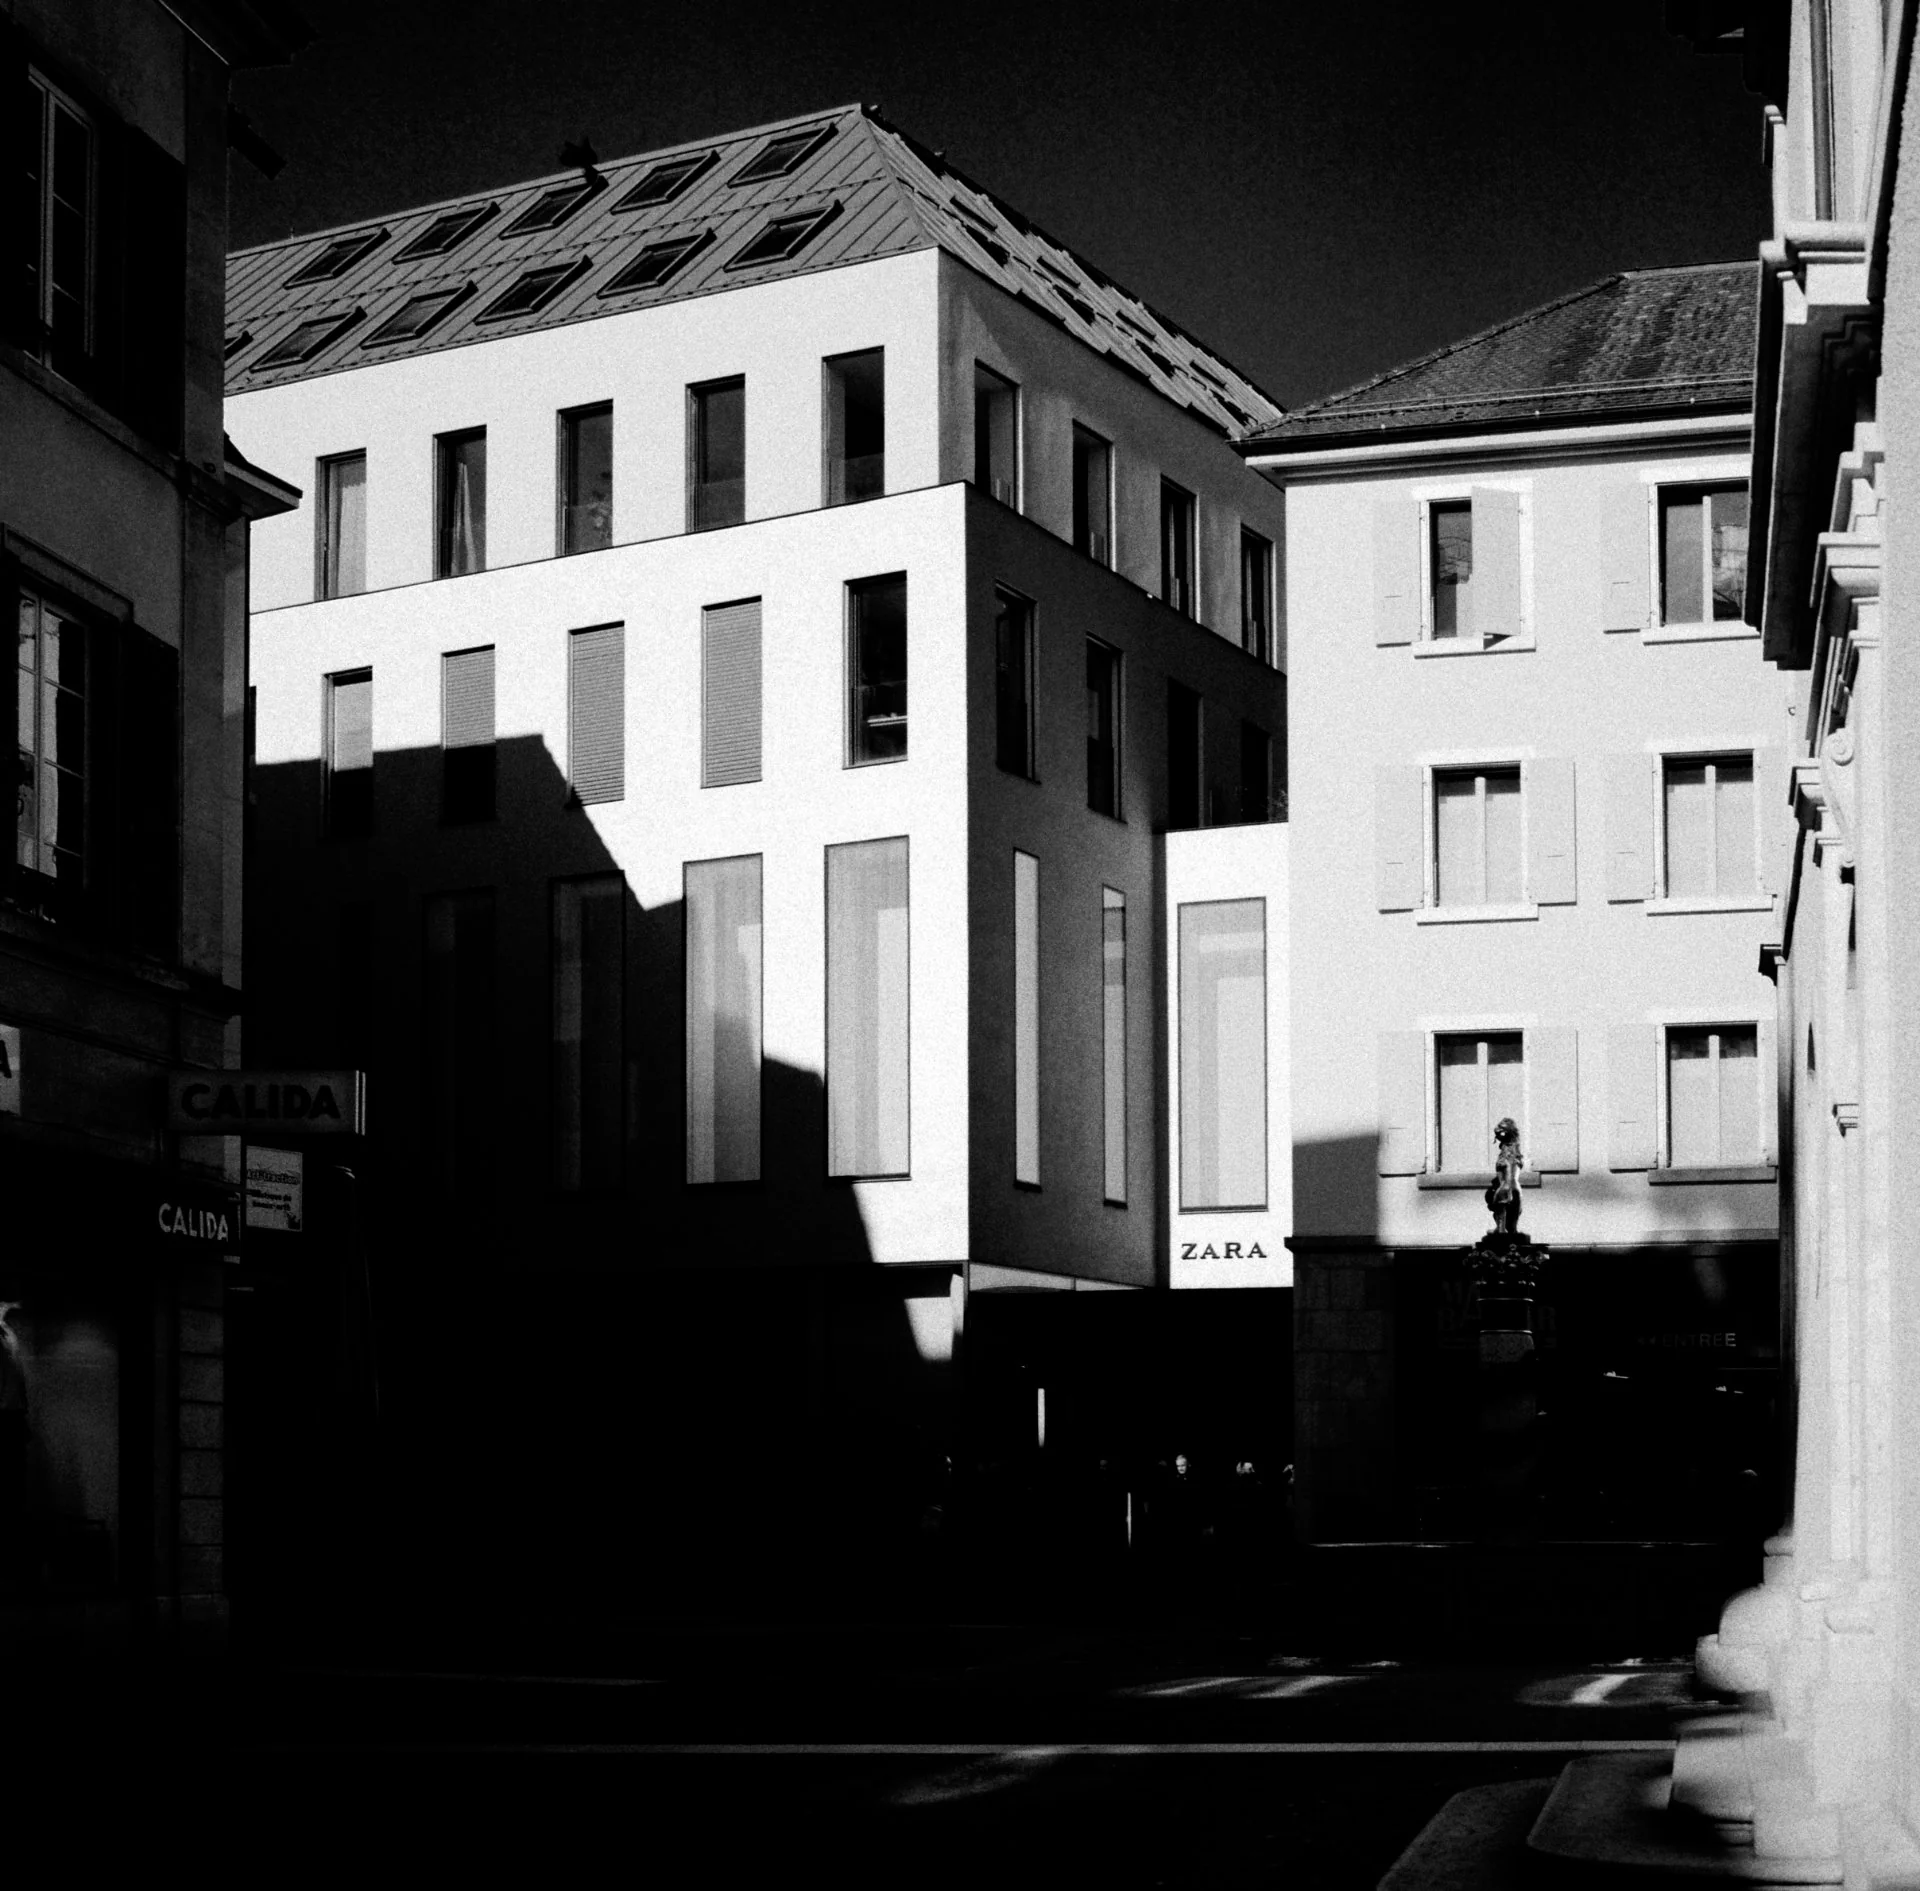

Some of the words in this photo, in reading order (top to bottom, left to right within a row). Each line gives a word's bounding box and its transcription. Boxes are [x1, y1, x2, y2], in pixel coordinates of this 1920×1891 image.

[182, 1083, 341, 1119] CALIDA
[158, 1202, 229, 1242] CALIDA
[1181, 1241, 1268, 1260] ZARA
[1661, 1331, 1737, 1348] ENTREE
